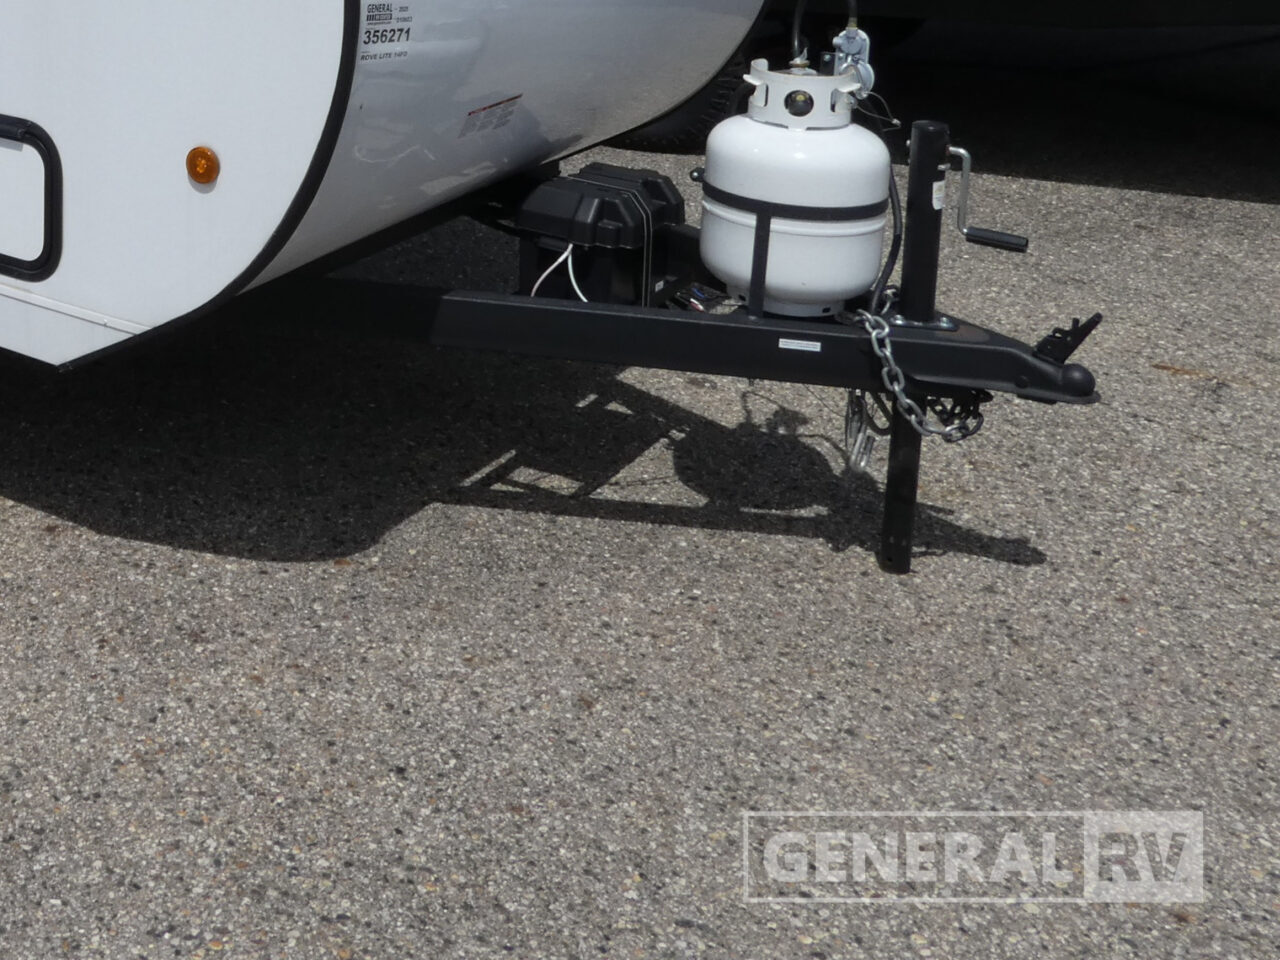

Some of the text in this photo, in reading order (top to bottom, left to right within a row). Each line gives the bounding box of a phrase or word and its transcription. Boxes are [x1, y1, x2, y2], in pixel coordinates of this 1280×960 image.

[367, 3, 393, 13] GENERAL
[363, 27, 411, 45] 356271
[379, 52, 392, 60] LITE
